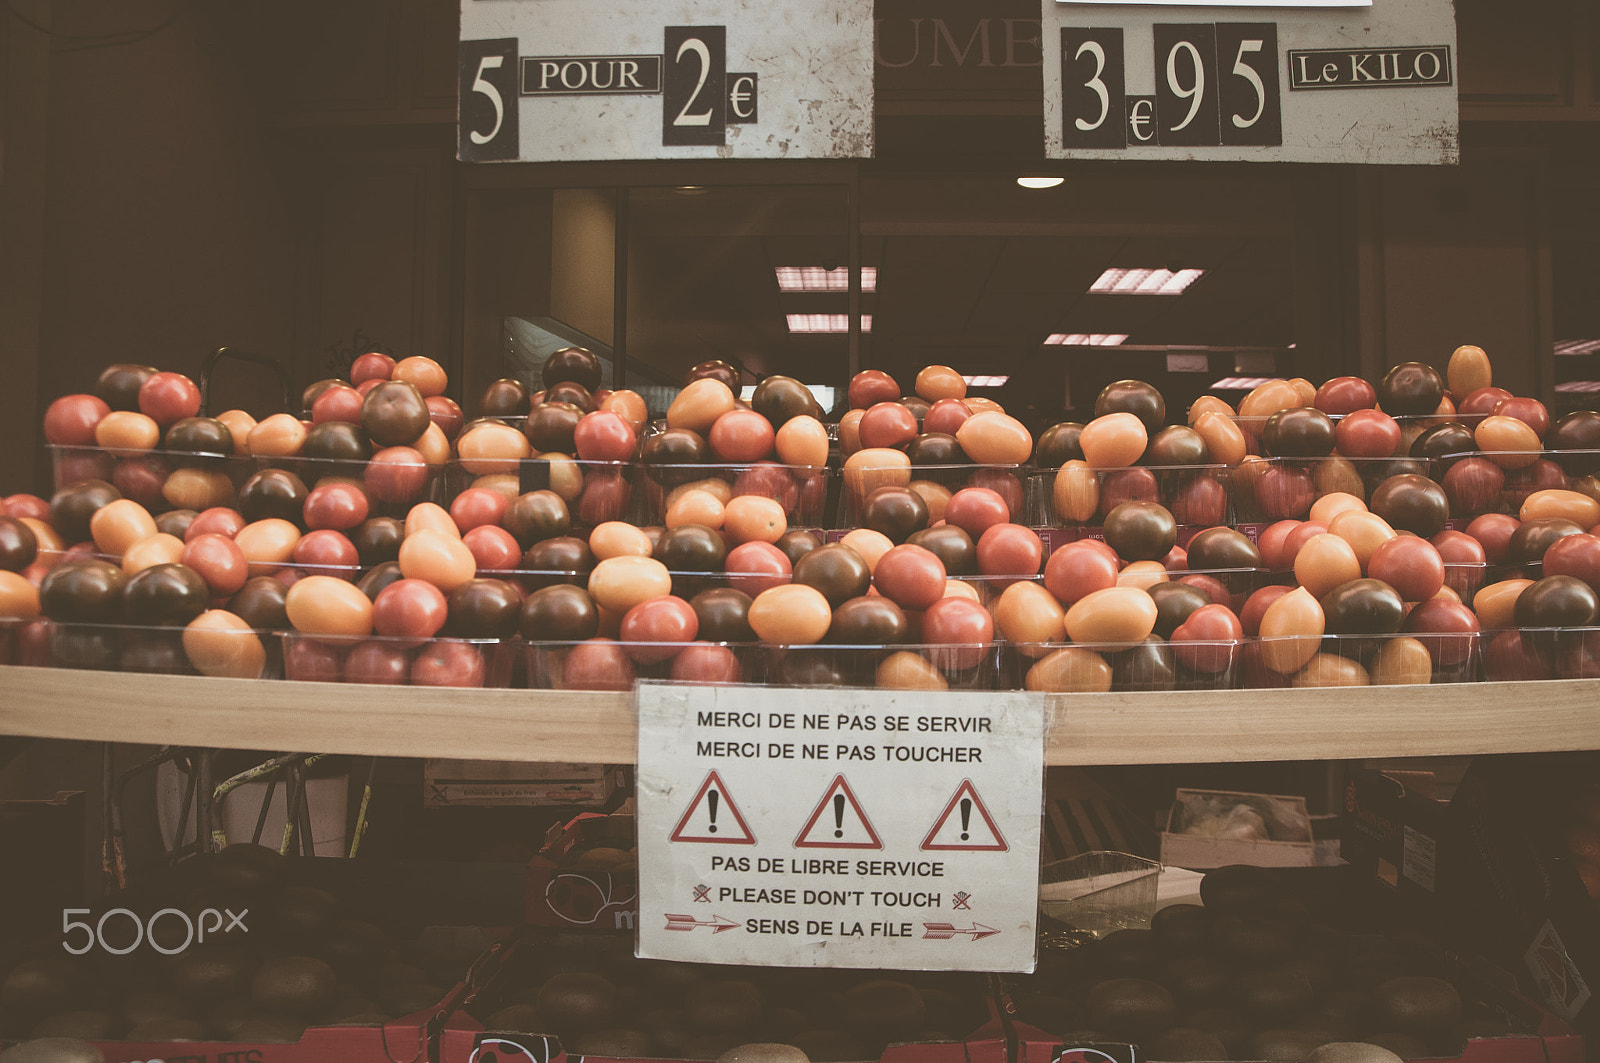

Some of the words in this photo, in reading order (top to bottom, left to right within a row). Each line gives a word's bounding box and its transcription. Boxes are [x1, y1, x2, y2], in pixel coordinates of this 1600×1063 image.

[1297, 56, 1339, 83] Le
[1349, 51, 1441, 82] KILO
[470, 55, 504, 145] 5
[539, 60, 644, 89] POUR
[697, 711, 761, 728] MERCI
[768, 713, 796, 729] DE
[803, 714, 830, 730] NE
[837, 714, 877, 731] PAS
[883, 715, 910, 732] SE
[916, 716, 992, 733] SERVIR
[696, 741, 760, 758] MERCI
[768, 743, 795, 759] DE
[802, 744, 829, 760] NE
[836, 744, 876, 761] PAS
[882, 745, 983, 763] TOUCHER
[711, 855, 751, 873] PAS
[757, 857, 785, 874] DE
[791, 858, 849, 875] LIBRE
[855, 860, 945, 877] SERVICE
[719, 887, 797, 905] PLEASE
[803, 889, 865, 907] DON'T
[870, 891, 941, 908] TOUCH
[745, 918, 800, 935] SENS
[806, 920, 834, 936] DE
[839, 921, 865, 937] LA
[870, 922, 913, 938] FILE
